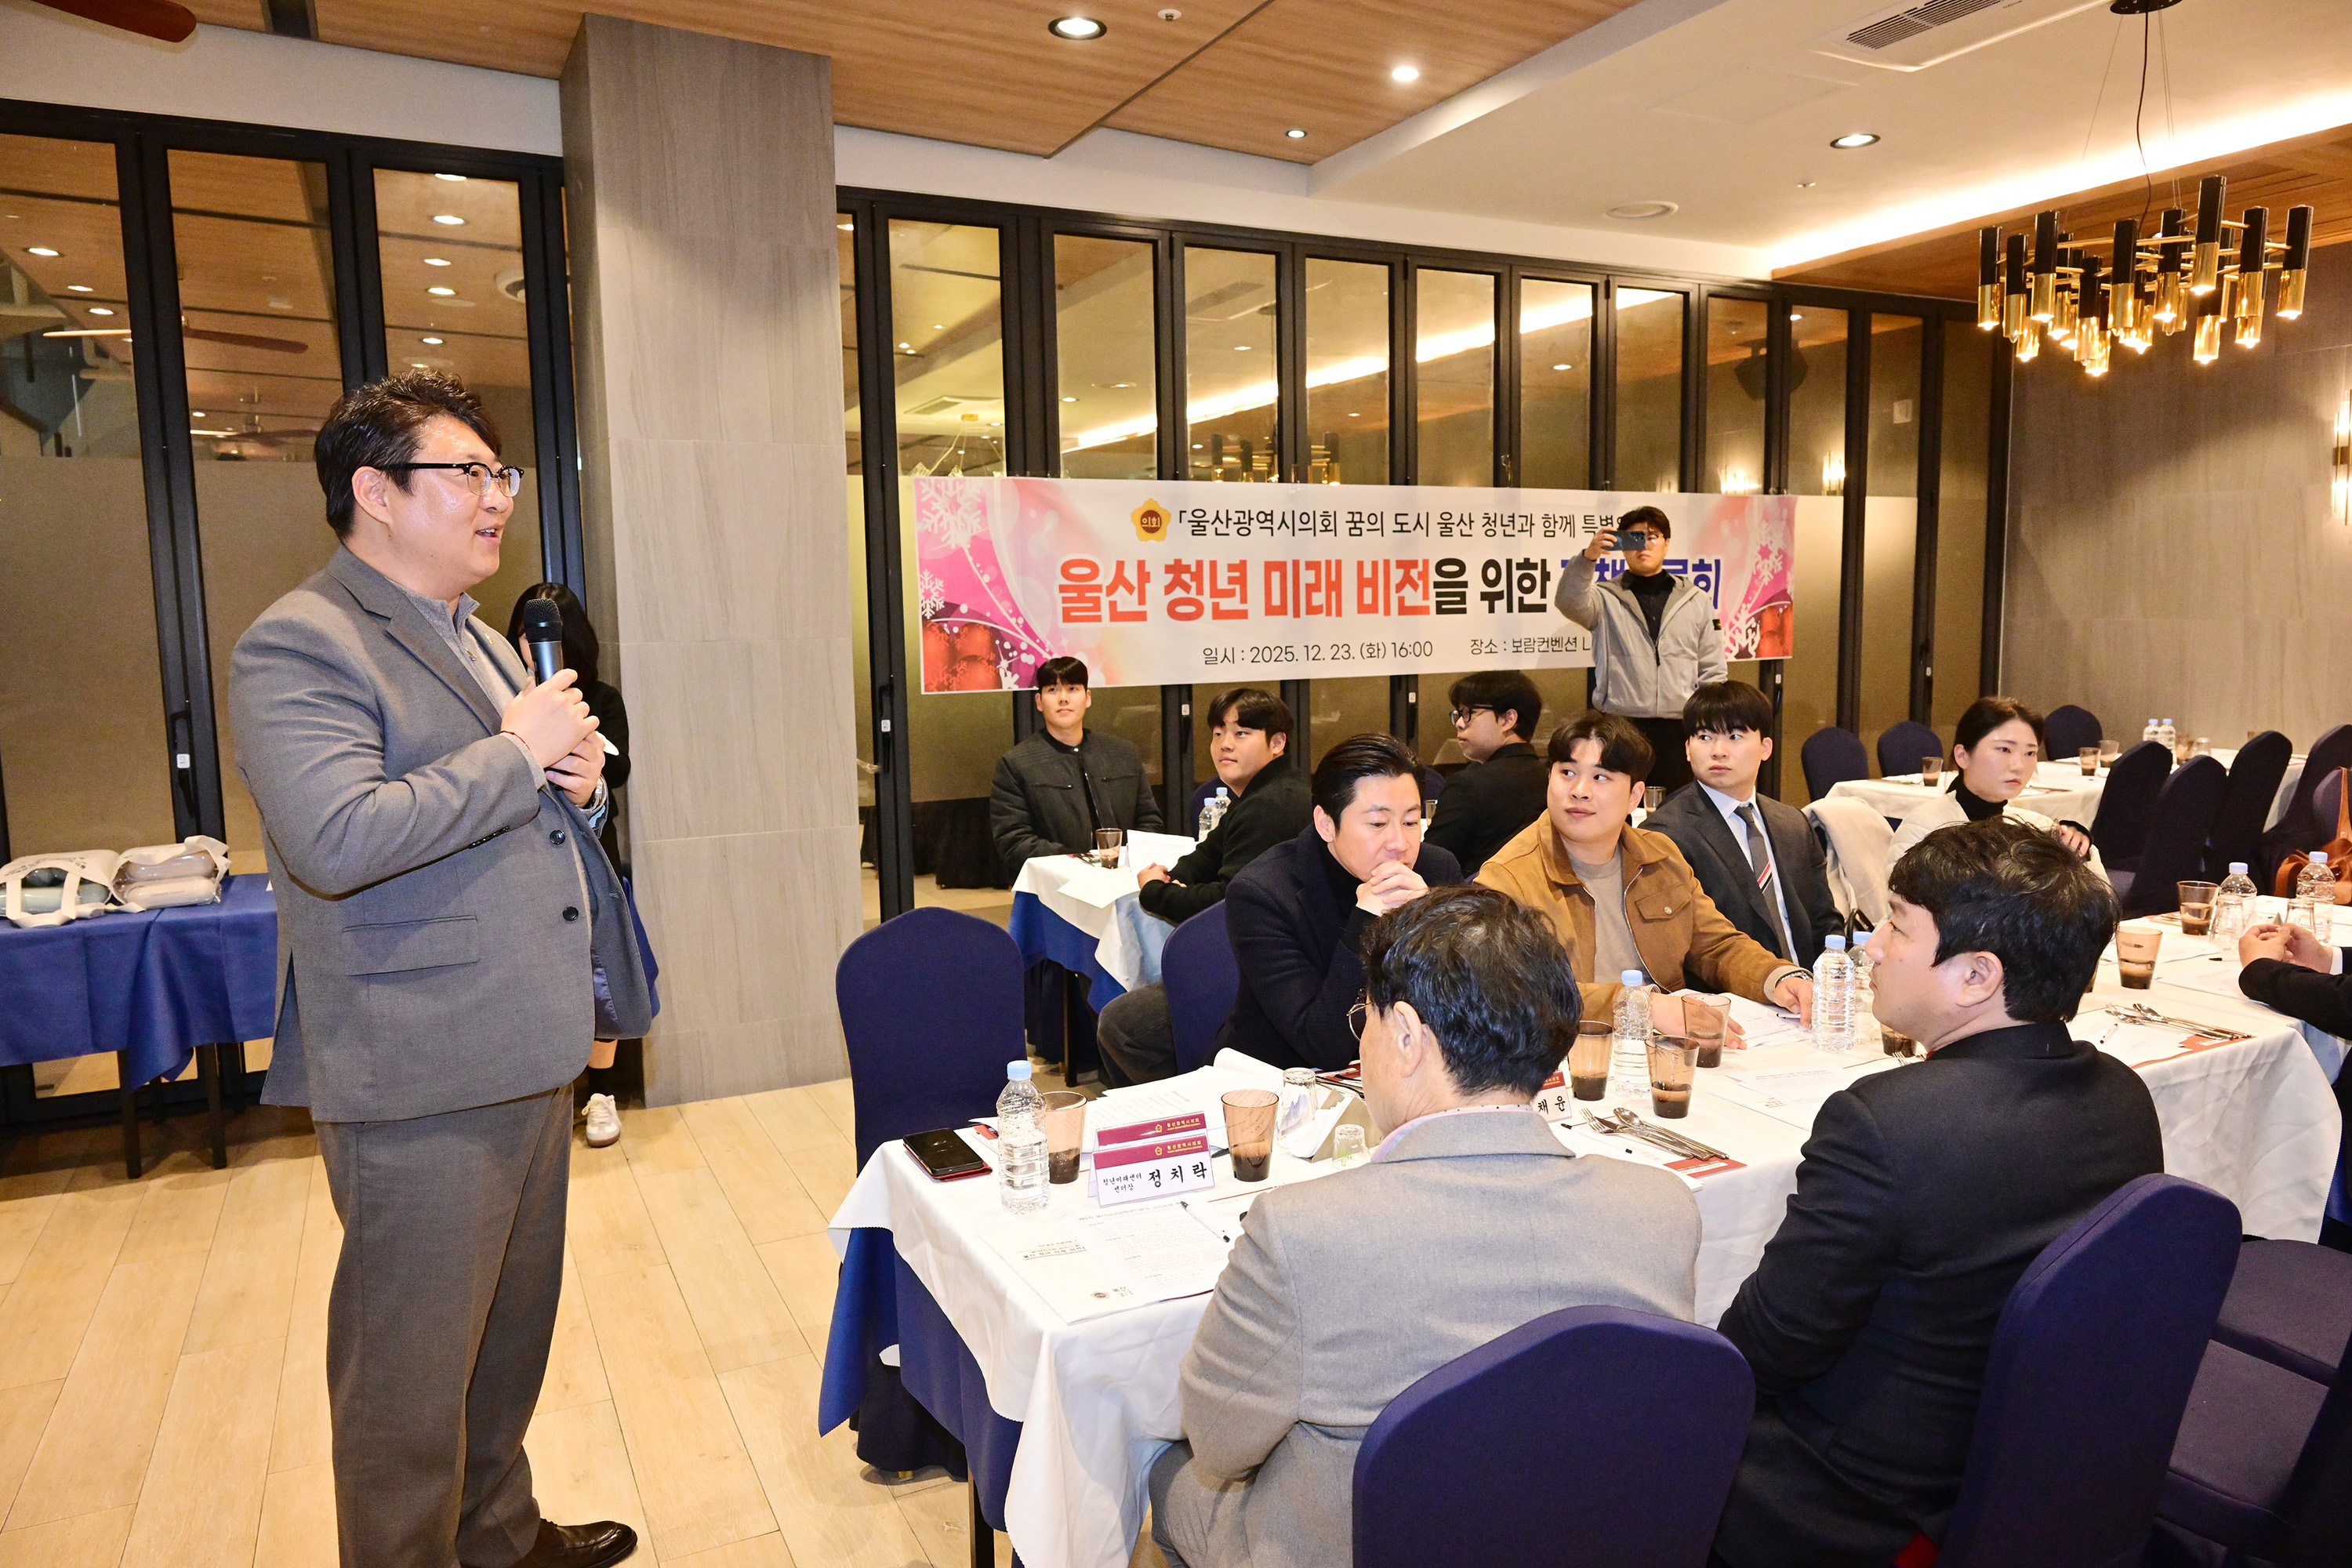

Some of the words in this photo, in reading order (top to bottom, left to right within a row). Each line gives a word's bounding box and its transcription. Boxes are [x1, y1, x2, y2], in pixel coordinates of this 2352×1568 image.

[1141, 516, 1160, 528] 의회
[1345, 511, 1384, 537] 꿈의
[1392, 512, 1429, 538] 도시
[1437, 511, 1475, 537] 울산
[1482, 512, 1535, 538] 청년과
[1541, 514, 1575, 538] 함께
[1582, 514, 1622, 535] 특별
[1058, 558, 1151, 623] 울산
[1163, 558, 1249, 622] 청년
[1264, 559, 1342, 619] 미래
[1356, 557, 1468, 617] 비전을
[1480, 557, 1551, 614] 위한
[1203, 647, 1235, 665] 일시
[1360, 642, 1386, 662] (화)
[1392, 641, 1432, 658] 16:00
[1470, 638, 1498, 655] 장소
[1512, 637, 1577, 654] 보람컨벤션
